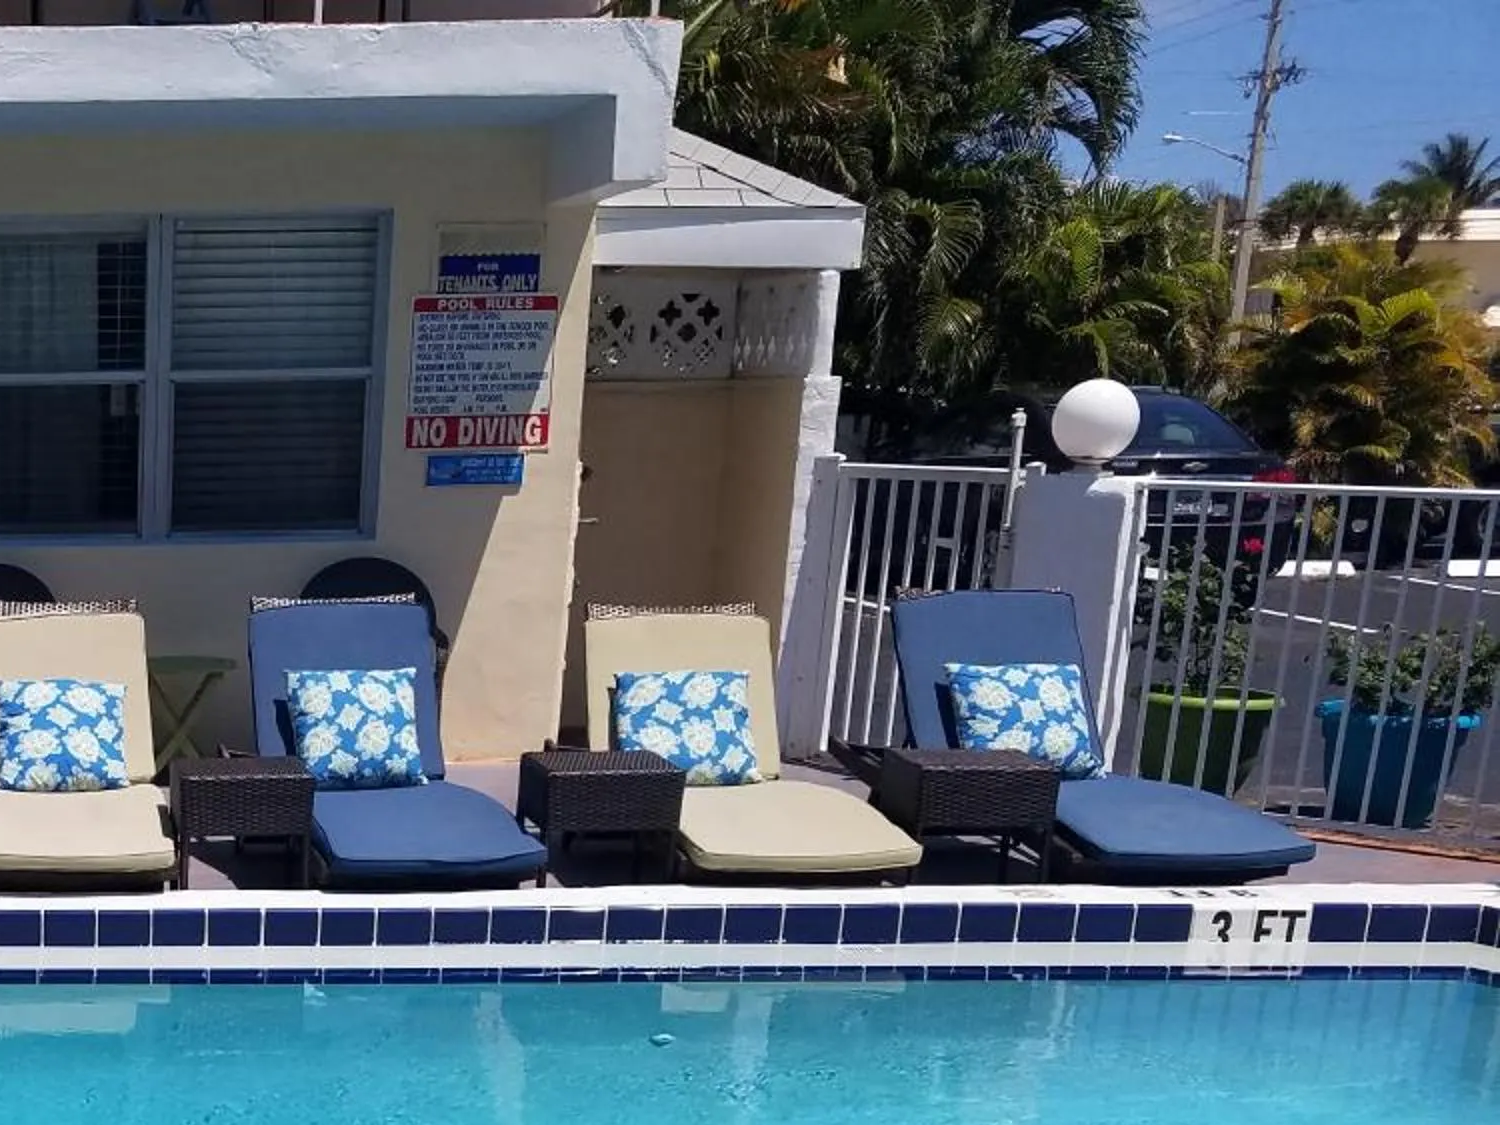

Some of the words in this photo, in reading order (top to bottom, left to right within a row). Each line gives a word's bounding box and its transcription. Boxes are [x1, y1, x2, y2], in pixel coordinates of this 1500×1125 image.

[438, 275, 498, 293] TENANTS
[502, 273, 538, 291] ONLY
[437, 298, 477, 311] POOL
[485, 297, 534, 309] RULES
[411, 417, 447, 447] NO
[457, 415, 542, 446] DIVING
[1212, 910, 1233, 942] 3
[1253, 910, 1307, 942] FT
